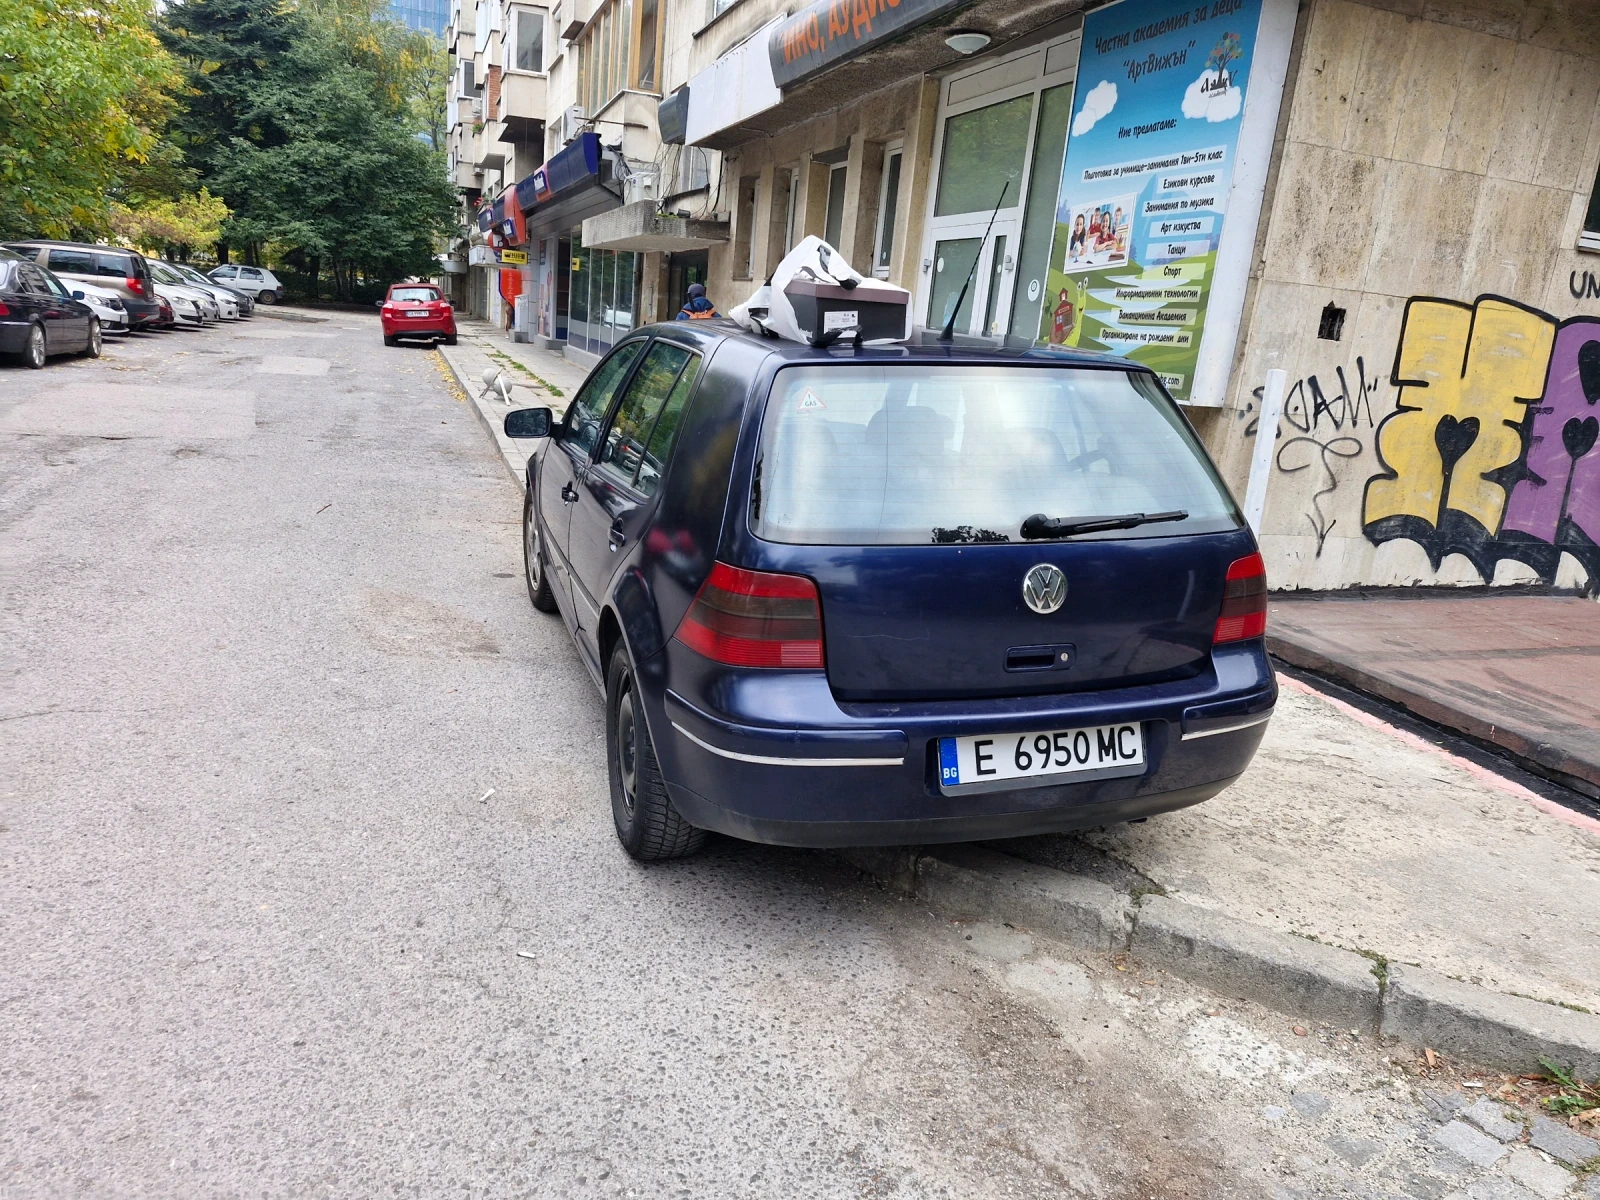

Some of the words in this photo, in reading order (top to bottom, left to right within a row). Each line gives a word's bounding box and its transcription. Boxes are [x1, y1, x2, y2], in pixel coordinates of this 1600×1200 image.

[1095, 32, 1131, 55] Частна
[1133, 11, 1190, 43] академия
[1192, 4, 1208, 24] за
[1210, 0, 1243, 19] деца
[1118, 126, 1131, 139] Ние
[1133, 117, 1178, 139] предлагаме:
[1084, 169, 1111, 180] Подготовка
[1113, 167, 1120, 176] за
[1207, 150, 1223, 161] клас
[1163, 178, 1188, 190] Езикови
[1189, 174, 1215, 188] курсове
[1145, 201, 1179, 213] Занимания
[1180, 200, 1188, 209] по
[1189, 197, 1215, 210] музика
[1160, 222, 1172, 235] Арт
[1173, 221, 1202, 233] изкуства
[1167, 243, 1187, 256] Танци
[1163, 265, 1182, 279] Спорт
[1115, 287, 1163, 301] Информационни
[1164, 289, 1199, 299] технологии
[1156, 310, 1187, 321] Академия
[1101, 329, 1139, 342] Организиране
[1140, 332, 1148, 341] на
[1148, 332, 1174, 344] рождени
[1176, 334, 1189, 343] дни
[974, 739, 997, 776] E
[1014, 730, 1090, 771] 6950
[1096, 725, 1137, 764] MC
[943, 767, 958, 779] BG
